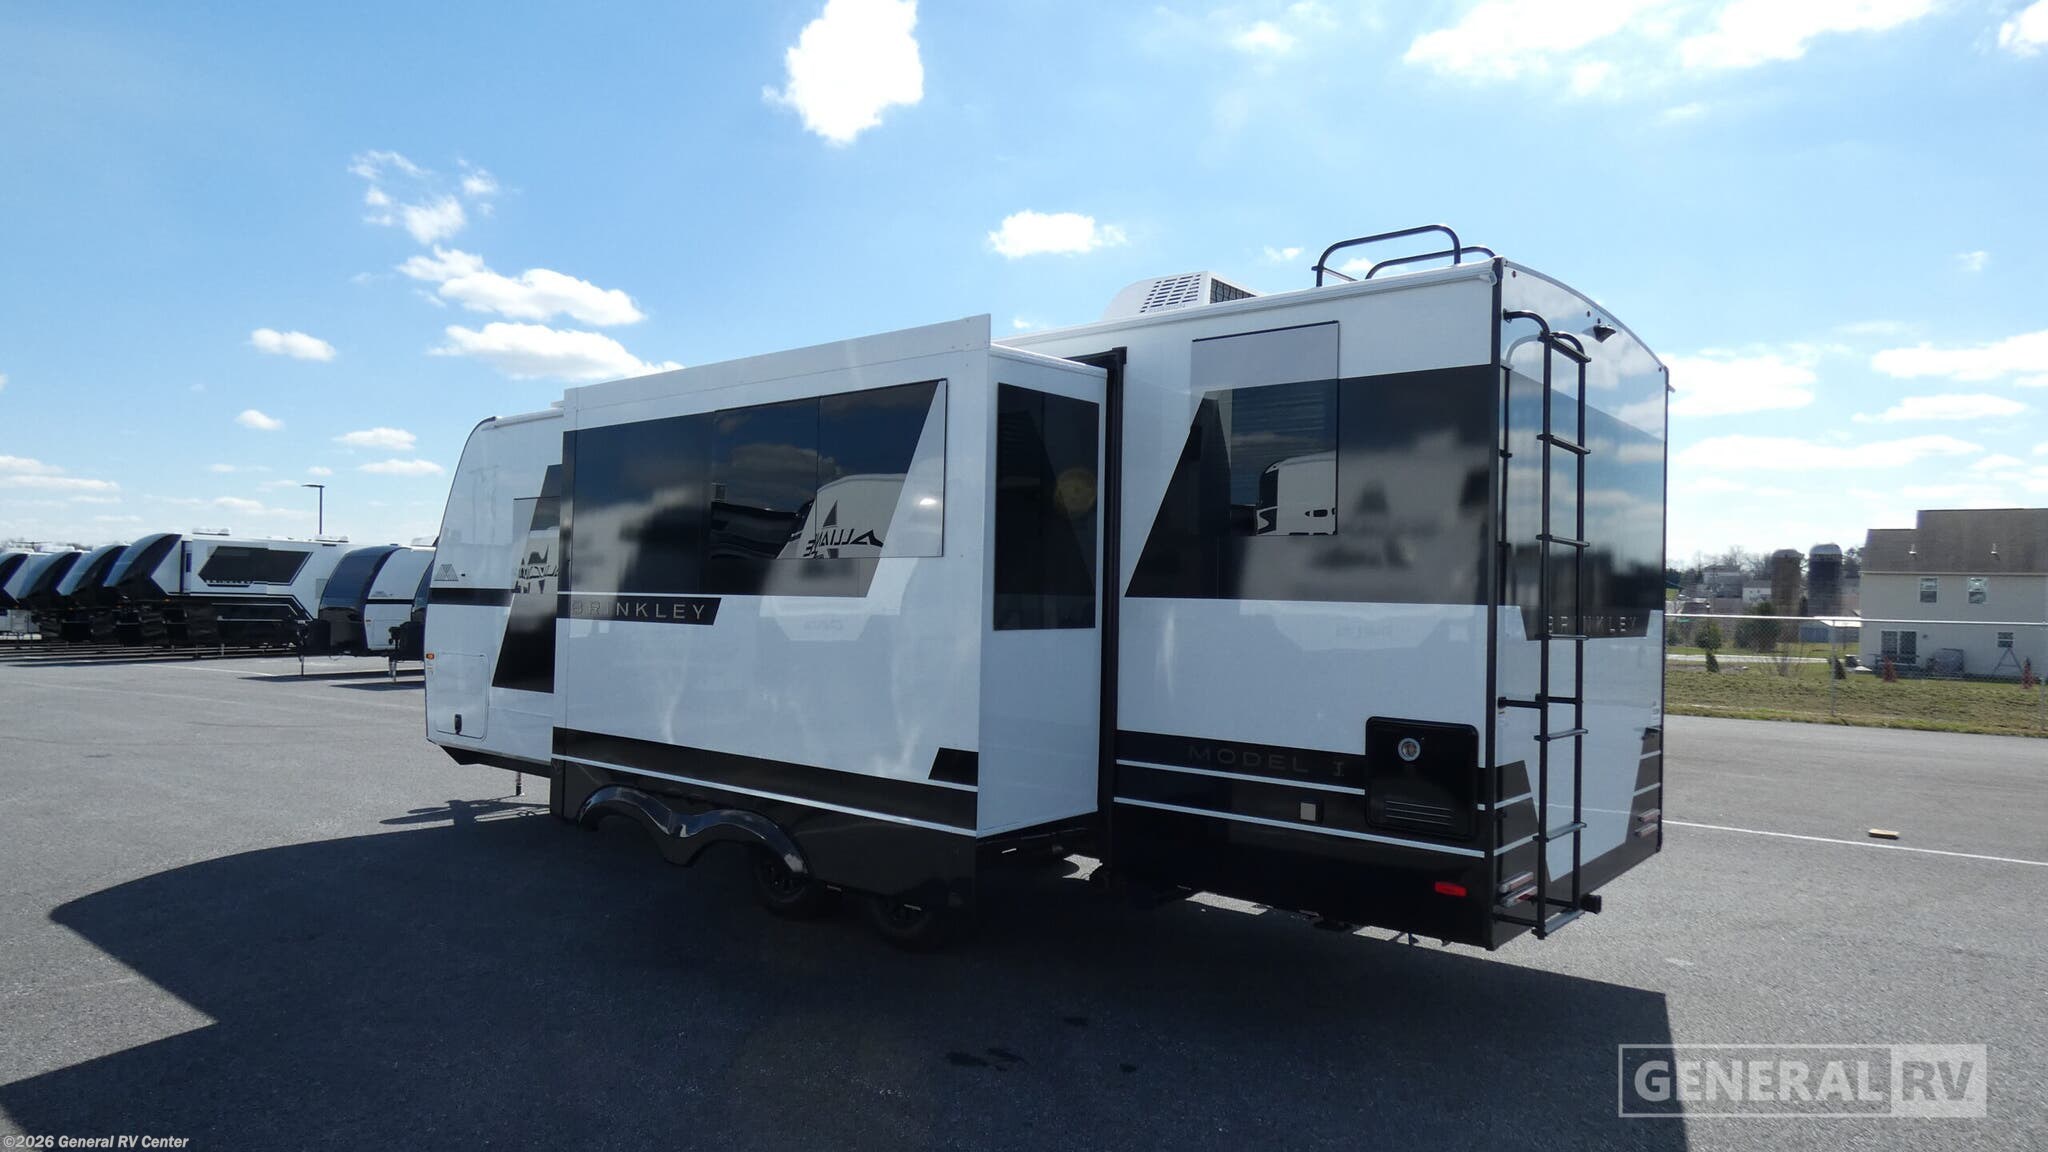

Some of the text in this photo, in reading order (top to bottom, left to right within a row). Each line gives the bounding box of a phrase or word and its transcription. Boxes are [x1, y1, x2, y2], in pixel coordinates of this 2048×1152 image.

[572, 602, 705, 620] BRINKLEY
[1546, 615, 1638, 633] BRNKLEY
[1187, 745, 1310, 774] MODEL
